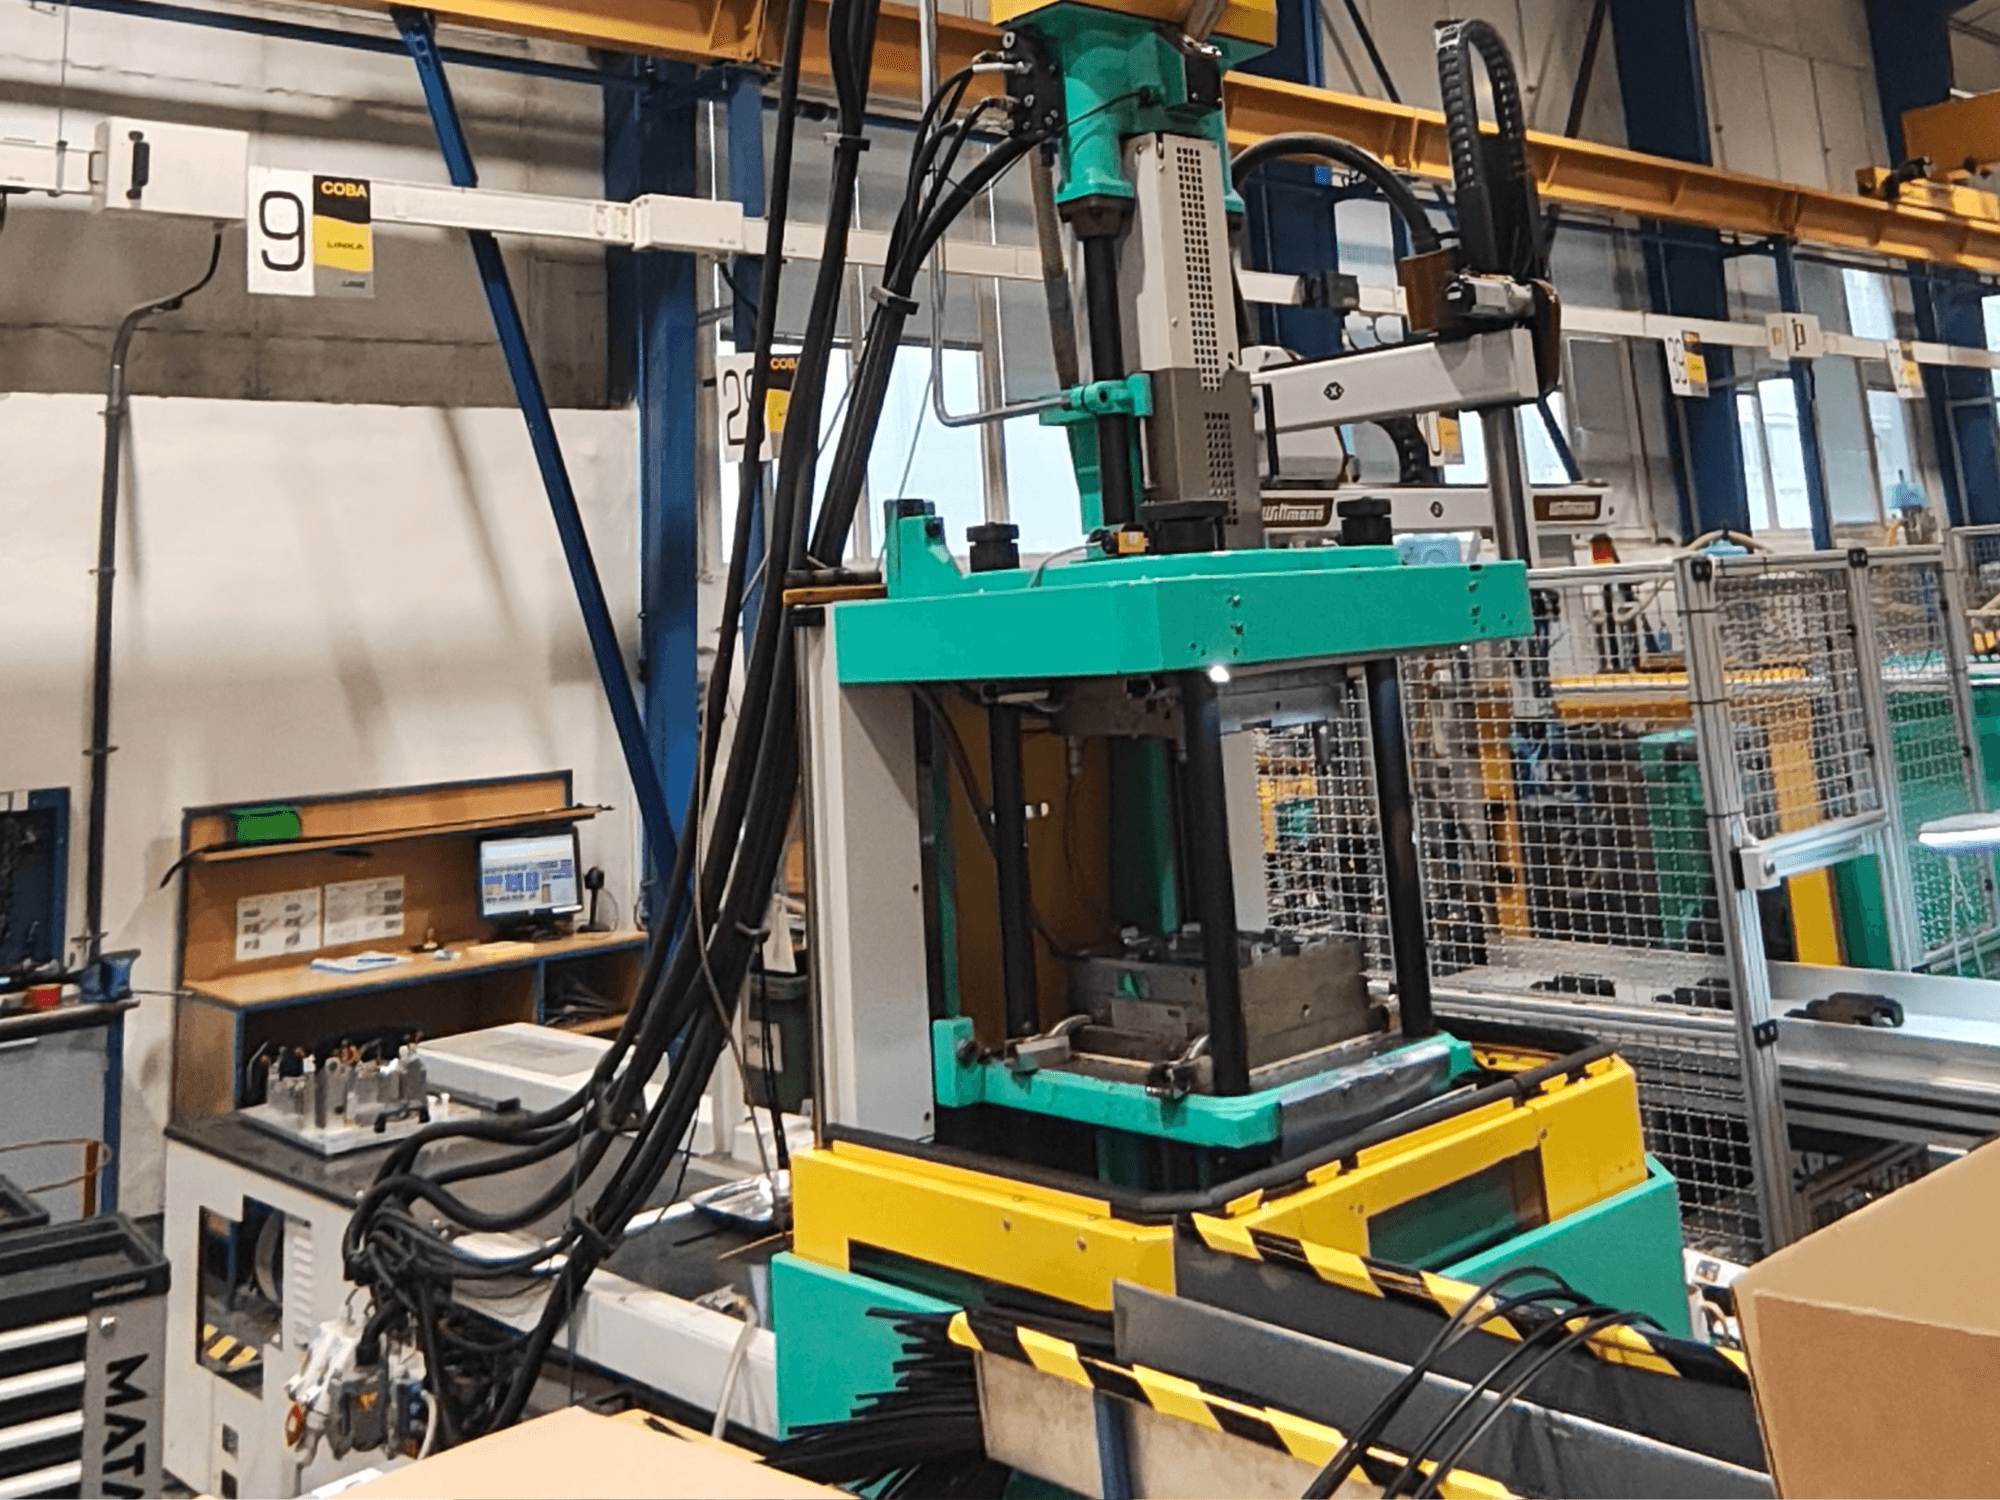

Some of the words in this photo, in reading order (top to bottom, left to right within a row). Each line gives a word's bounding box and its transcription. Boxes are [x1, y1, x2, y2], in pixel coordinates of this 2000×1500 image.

[321, 181, 367, 198] COBA
[259, 190, 305, 272] 9
[770, 357, 797, 370] COB
[1262, 504, 1325, 521] Wittmann
